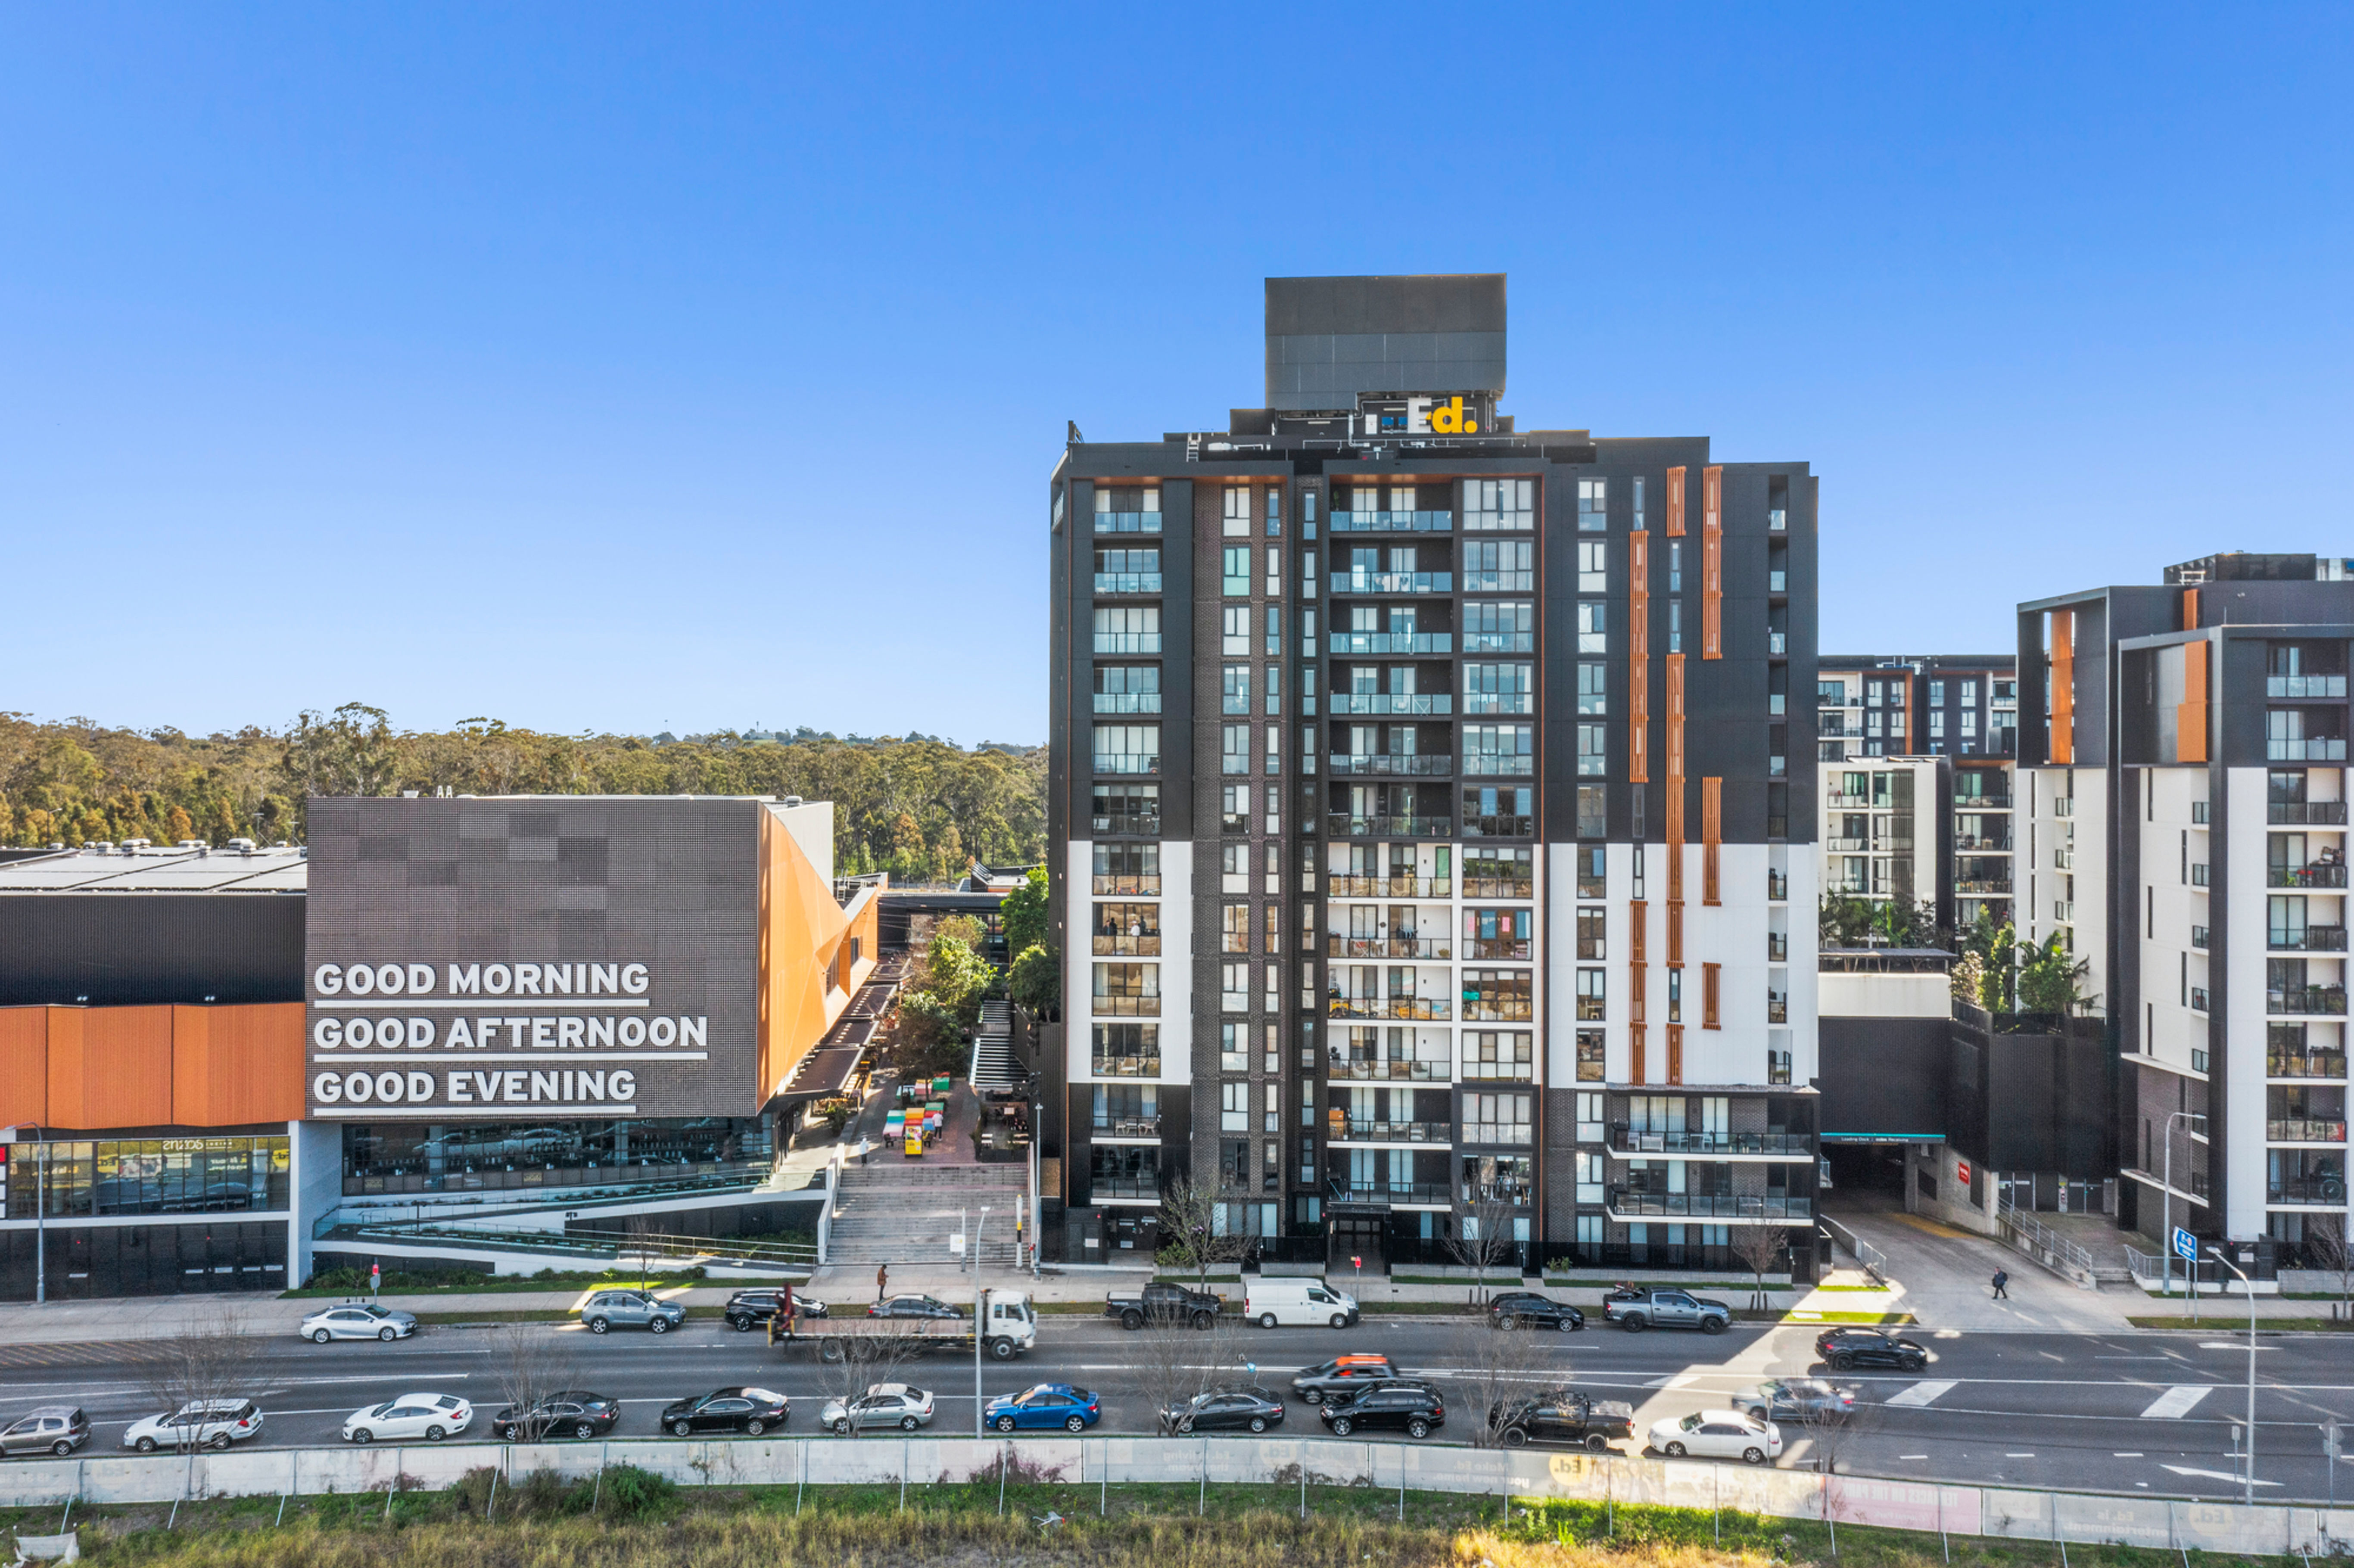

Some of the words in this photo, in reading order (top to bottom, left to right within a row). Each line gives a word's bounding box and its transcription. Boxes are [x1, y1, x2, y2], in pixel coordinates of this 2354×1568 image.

[1408, 396, 1478, 434] Ed.
[314, 964, 436, 995] GOOD
[448, 963, 649, 994] MORNING
[314, 1017, 435, 1048] GOOD
[445, 1017, 707, 1048] AFTERNOON
[314, 1071, 435, 1103] GOOD
[448, 1070, 636, 1101] EVENING
